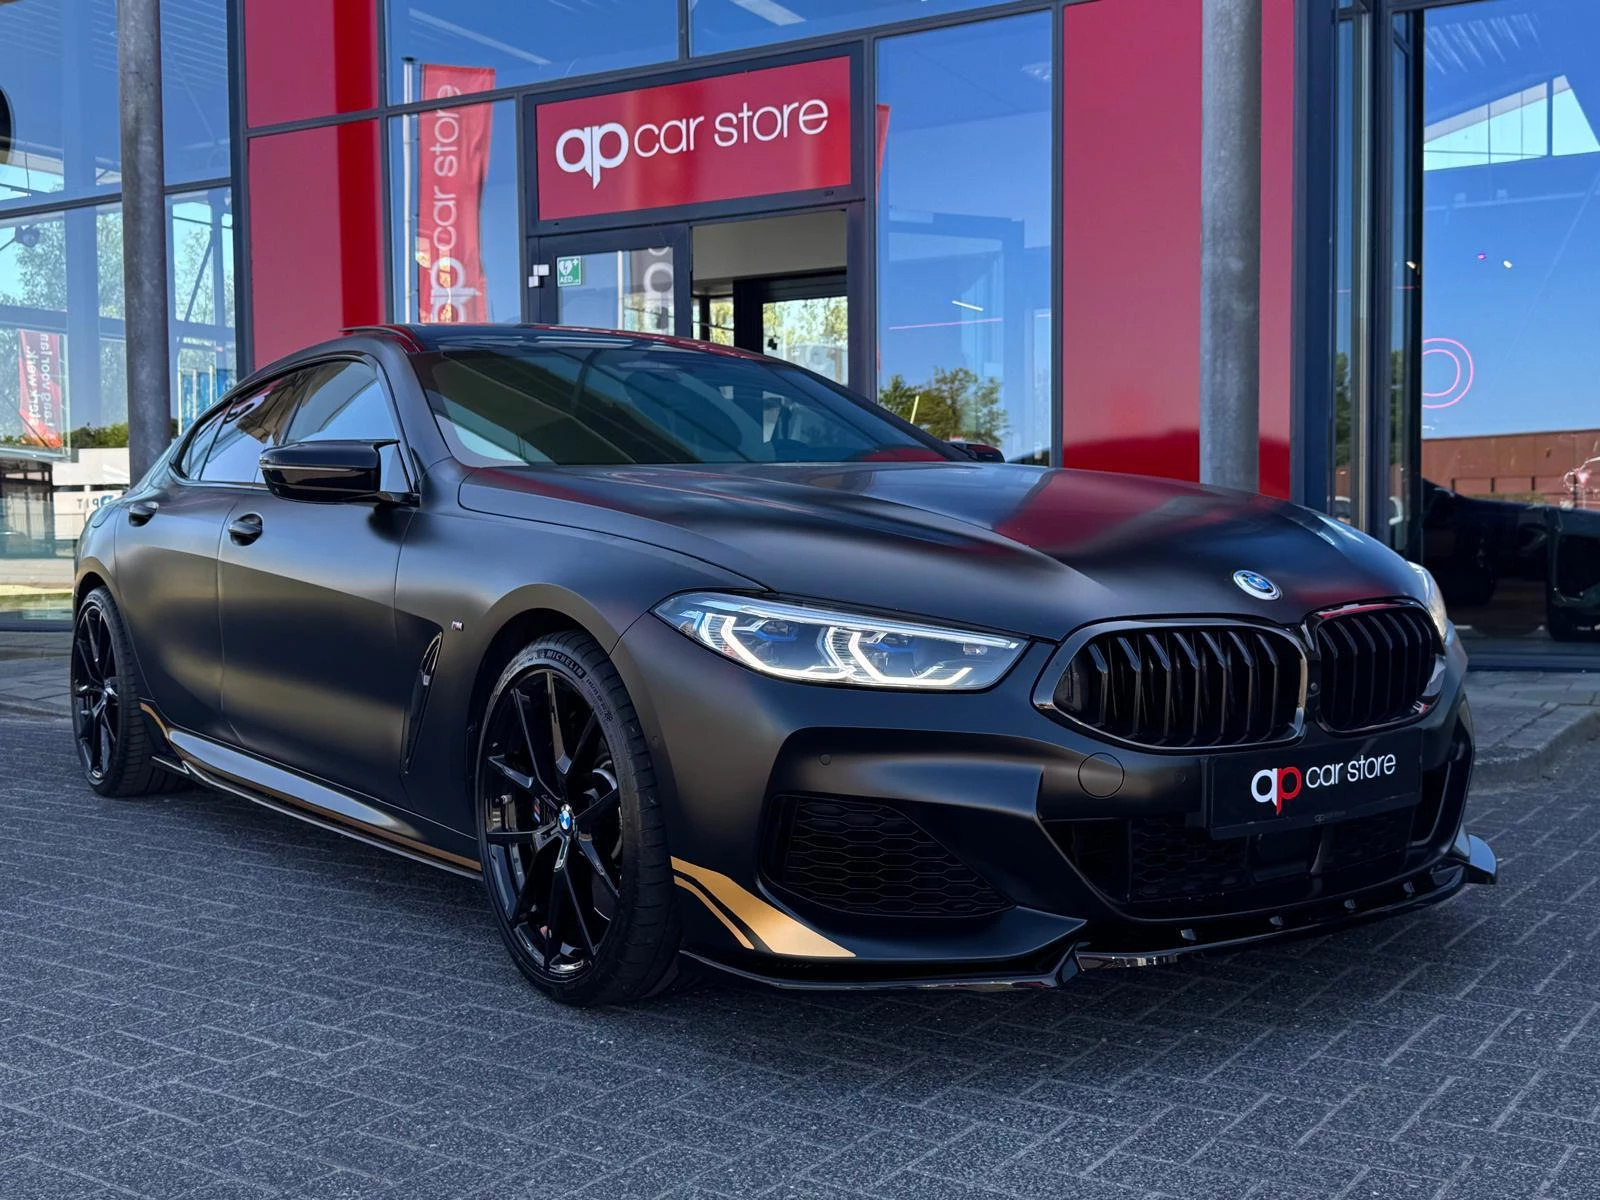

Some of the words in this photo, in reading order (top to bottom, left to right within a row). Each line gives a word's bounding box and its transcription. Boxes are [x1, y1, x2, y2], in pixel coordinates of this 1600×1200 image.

[555, 121, 629, 190] ap
[634, 115, 704, 158] car
[714, 98, 829, 147] store
[433, 185, 457, 250] car
[559, 275, 573, 284] AED
[546, 650, 584, 676] MICHELIN
[1251, 766, 1302, 816] ap
[1306, 761, 1344, 788] car
[1347, 753, 1396, 782] store
